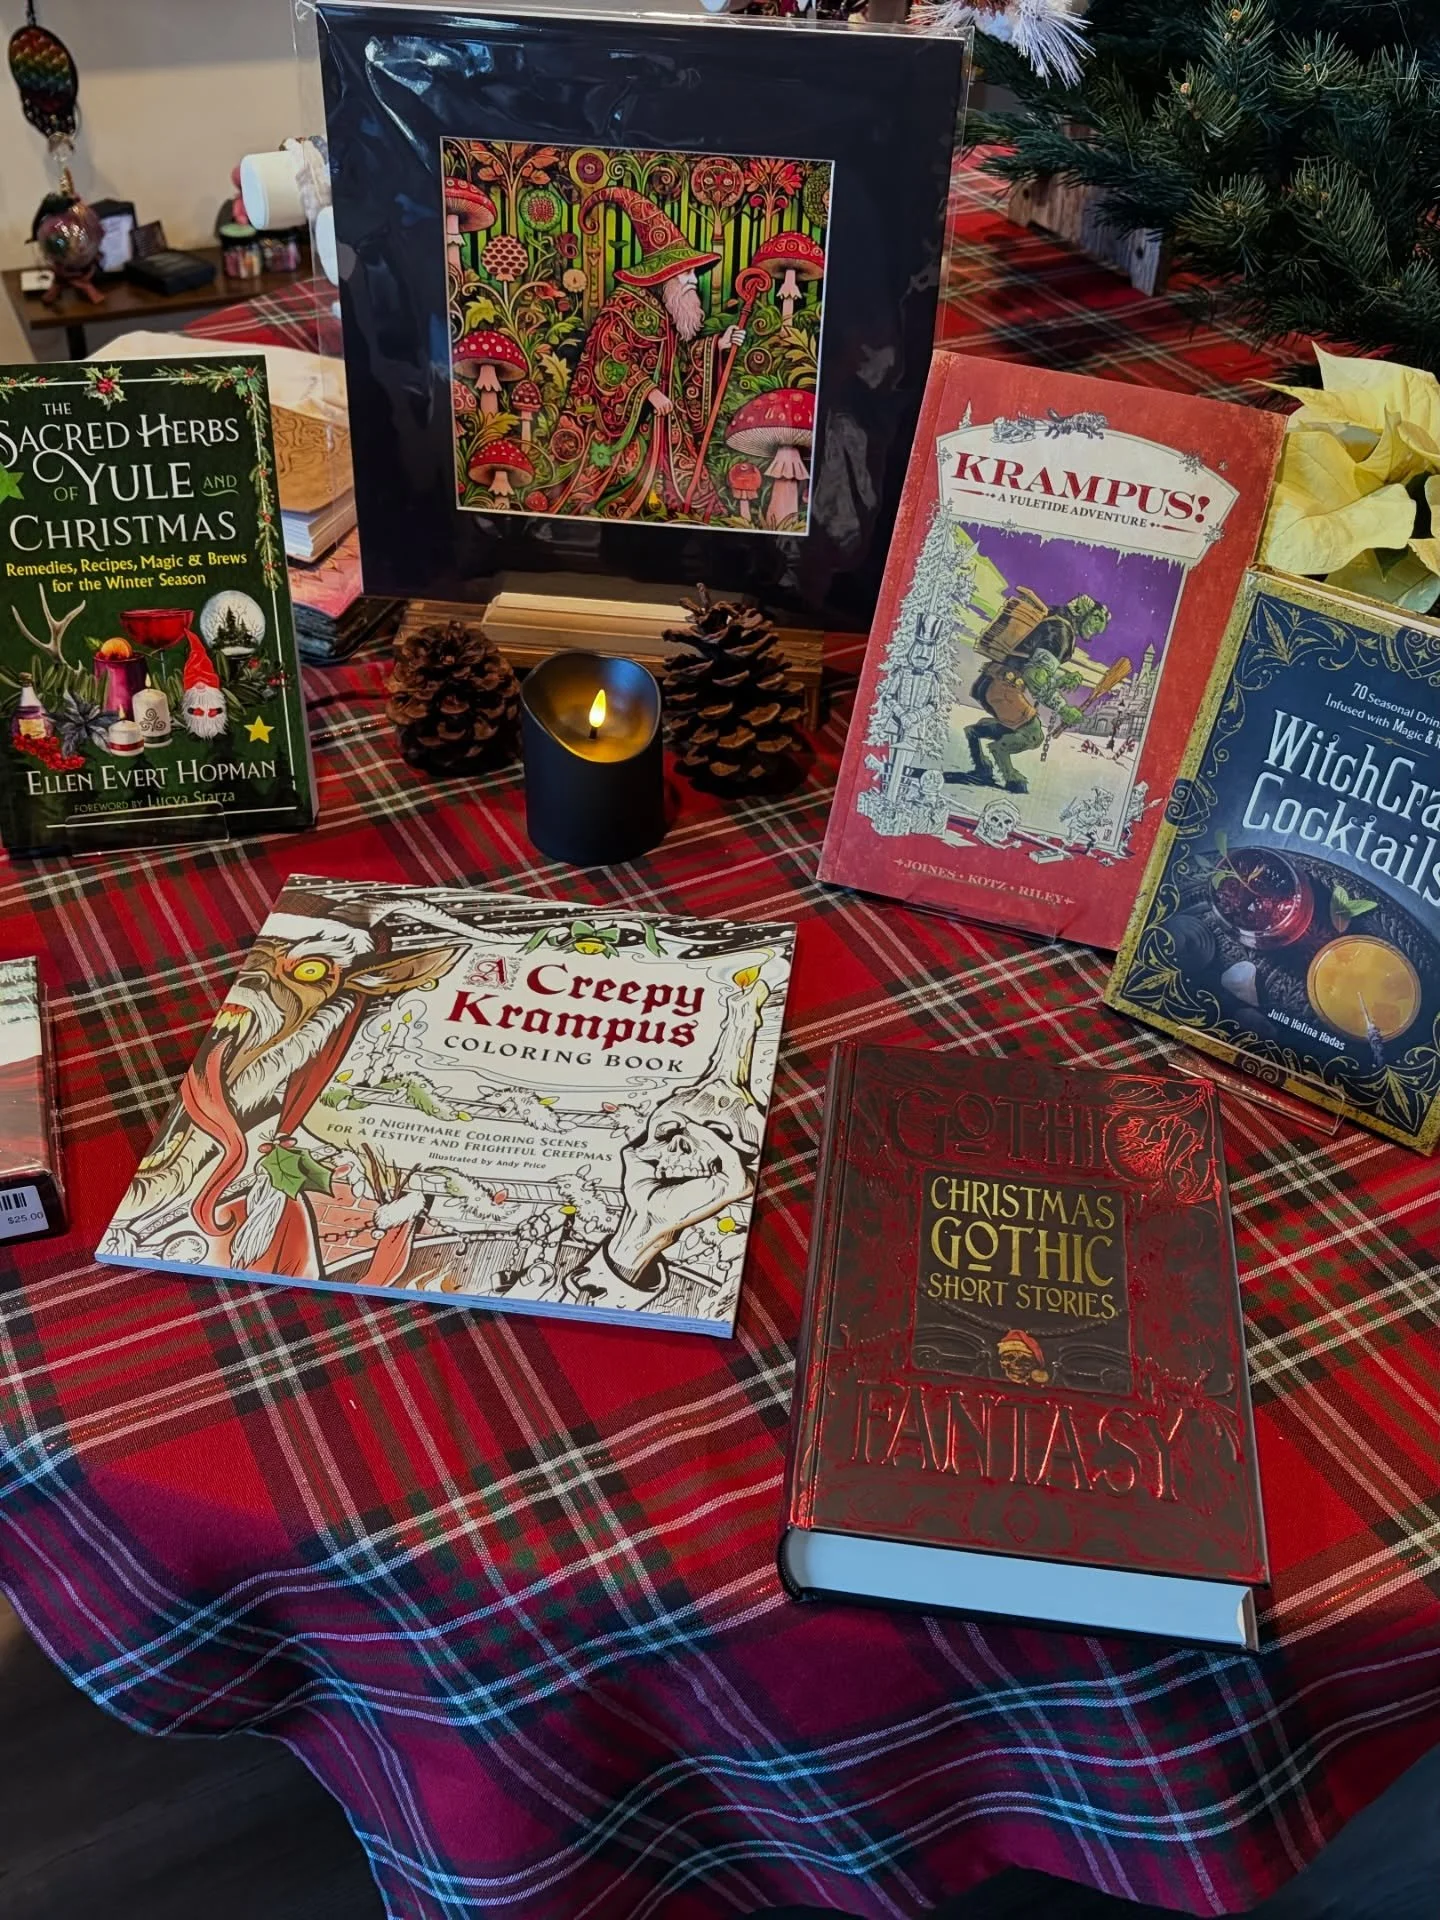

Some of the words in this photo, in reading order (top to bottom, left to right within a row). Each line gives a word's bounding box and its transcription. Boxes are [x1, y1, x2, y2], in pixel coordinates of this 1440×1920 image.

[42, 402, 72, 416] THE
[0, 420, 130, 469] SACRED
[136, 413, 240, 447] HERBS
[32, 450, 195, 506] YULE
[53, 486, 79, 502] OF
[202, 474, 240, 491] AND
[951, 451, 1211, 524] KRAMPUS!
[997, 493, 1007, 504] A
[1009, 494, 1069, 515] YULETIDE
[1070, 506, 1149, 529] ADVENTURE
[9, 511, 237, 552] CHRISTMAS
[6, 559, 78, 577] Remedies,
[81, 557, 138, 574] Recipes,
[140, 554, 184, 571] Magic
[188, 554, 202, 567] &
[208, 551, 248, 567] Brews
[52, 579, 73, 593] for
[78, 577, 101, 592] the
[104, 573, 156, 590] Winter
[159, 572, 206, 588] Season
[1325, 692, 1366, 719] Infused
[1366, 712, 1390, 728] with
[1392, 718, 1424, 740] Magic
[1424, 729, 1434, 744] &
[1351, 682, 1368, 700] 70
[1367, 692, 1415, 718] Seasonal
[26, 770, 94, 795] ELLEN
[101, 765, 168, 790] EVERT
[176, 759, 276, 785] HOPMAN
[74, 800, 129, 814] FOREWORD
[131, 799, 143, 809] BY
[904, 859, 956, 879] JOINES
[968, 874, 1007, 891] KOTZ
[1019, 886, 1065, 904] RILEY
[470, 956, 507, 985] A
[526, 963, 705, 1017] Creepy
[445, 990, 699, 1050] Krampus
[1267, 1008, 1290, 1026] Julia
[1290, 1018, 1318, 1039] Halina
[1319, 1031, 1346, 1051] Hadas
[443, 1035, 592, 1065] COLORING
[605, 1054, 684, 1073] BOOK
[327, 1123, 353, 1134] FOR
[358, 1127, 367, 1136] A
[372, 1128, 426, 1144] FESTIVE
[430, 1138, 459, 1150] AND
[464, 1141, 537, 1157] FRIGHTFUL
[542, 1148, 614, 1162] CREEPMAS
[358, 1116, 375, 1126] 30
[379, 1117, 462, 1138] NIGHTMARE
[466, 1131, 535, 1146] COLORING
[539, 1137, 588, 1149] SCENES
[890, 1086, 1165, 1185] GOTHIC
[428, 1152, 477, 1165] Illustrated
[480, 1156, 494, 1167] by
[496, 1158, 520, 1169] Andy
[523, 1161, 546, 1170] Price
[8, 1211, 43, 1225] $25.00
[931, 1175, 1115, 1231] CHRISTMAS
[930, 1216, 1113, 1287] GOTHIC
[927, 1273, 1009, 1308] SHORT
[1016, 1284, 1117, 1320] STORIES
[850, 1378, 1188, 1501] FANTASY
